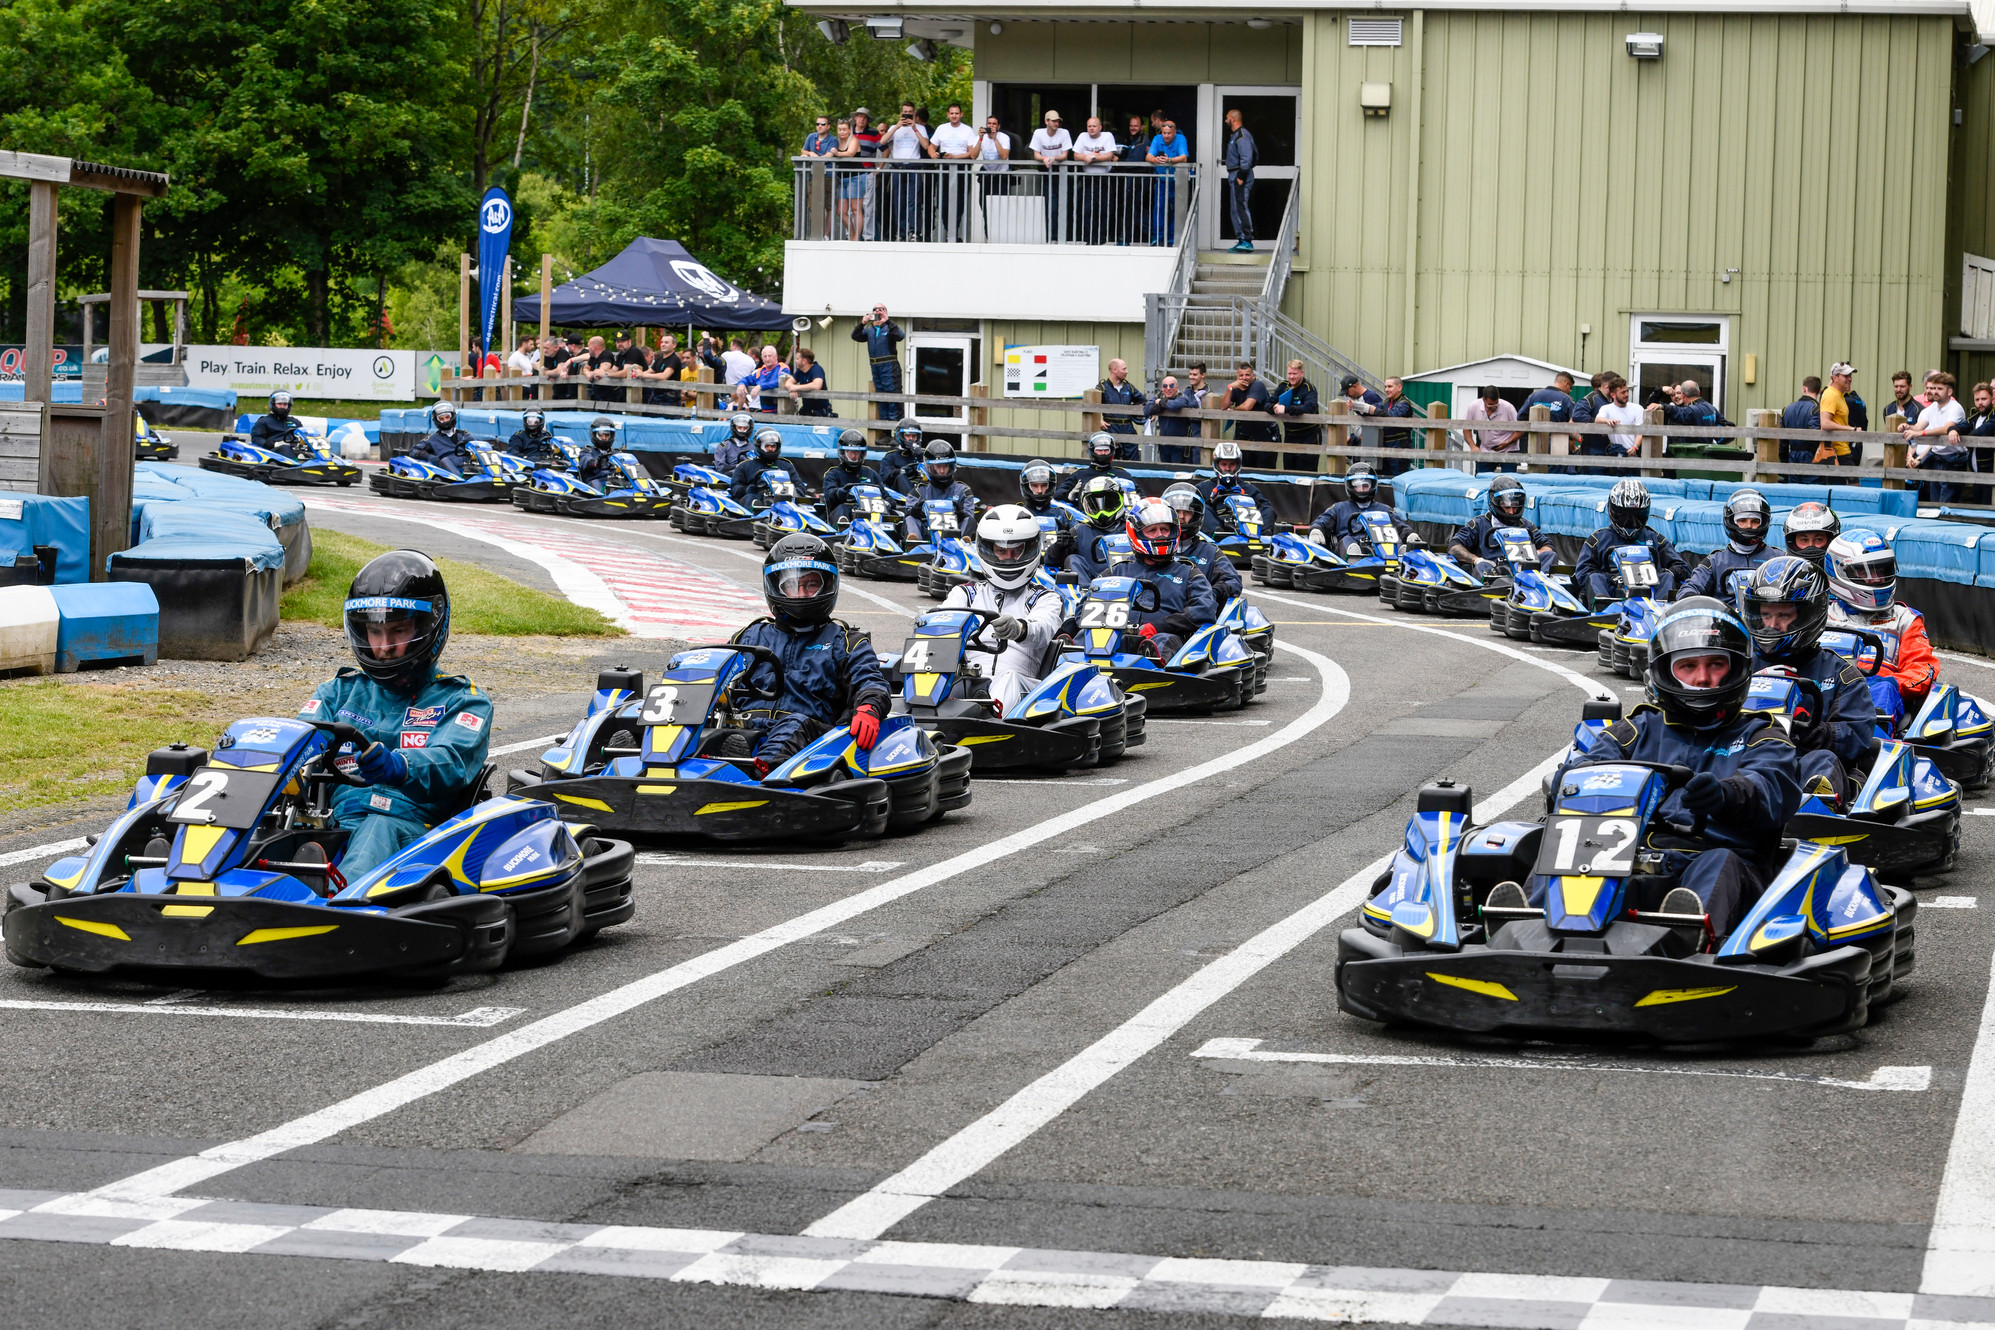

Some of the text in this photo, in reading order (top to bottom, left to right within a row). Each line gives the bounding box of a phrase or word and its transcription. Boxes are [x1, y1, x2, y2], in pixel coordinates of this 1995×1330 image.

[57, 364, 79, 372] .co.uk
[316, 363, 353, 379] Enjoy
[310, 438, 331, 450] 23
[482, 452, 502, 465] 14
[865, 499, 885, 513] 16
[929, 514, 957, 530] 25
[1236, 507, 1264, 525] 22
[1372, 526, 1399, 543] 19
[1505, 544, 1536, 561] 21
[771, 560, 831, 571] BUCKMORE PARK
[1621, 564, 1659, 585] 10
[345, 598, 416, 609] BUCKMORE PARK
[1080, 602, 1130, 627] 26
[1657, 608, 1739, 632] BUCKMORE PARK
[903, 640, 929, 670] 4
[643, 686, 678, 722] 3
[885, 742, 906, 762] BUCKMORE
[286, 744, 315, 783] BUCKMORE PARK
[335, 757, 356, 766] MINTE
[171, 772, 229, 820] 2
[1554, 819, 1638, 871] 12
[503, 845, 534, 872] BUCKMORE
[526, 851, 541, 862] PARK
[1843, 890, 1864, 918] BUCKMORE
